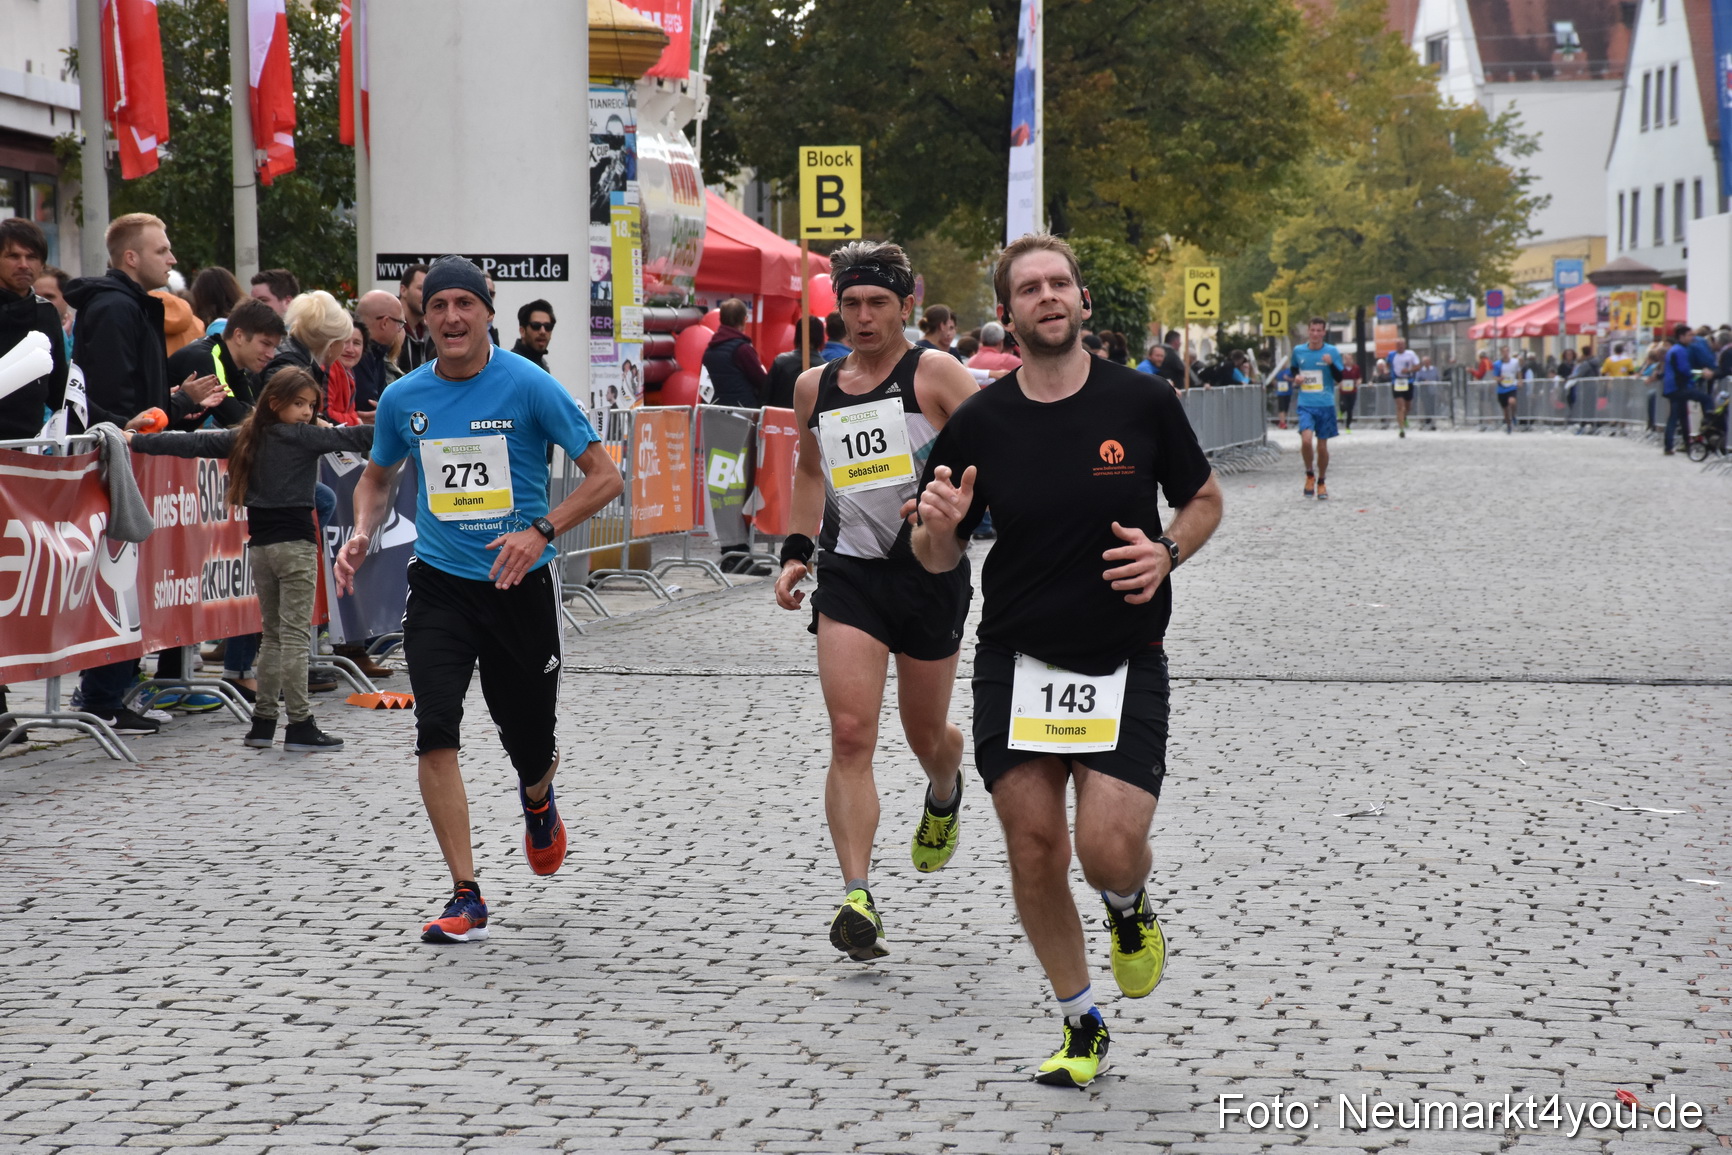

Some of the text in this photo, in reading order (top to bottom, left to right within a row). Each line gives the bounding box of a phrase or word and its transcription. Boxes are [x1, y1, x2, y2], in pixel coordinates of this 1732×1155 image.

[807, 150, 854, 167] Block
[816, 174, 846, 219] B
[1189, 269, 1215, 279] Block
[1193, 282, 1211, 307] C
[1648, 301, 1661, 319] D
[1269, 310, 1281, 328] D
[850, 410, 878, 422] BOCK
[470, 420, 513, 430] BOCK
[452, 445, 481, 453] BOCK
[841, 428, 887, 459] 103
[441, 462, 490, 489] 273
[848, 463, 890, 479] Sebastian
[453, 496, 484, 506] Johann
[459, 520, 503, 531] Stadtlauf
[1041, 683, 1096, 713] 143
[1045, 724, 1087, 736] Thomas
